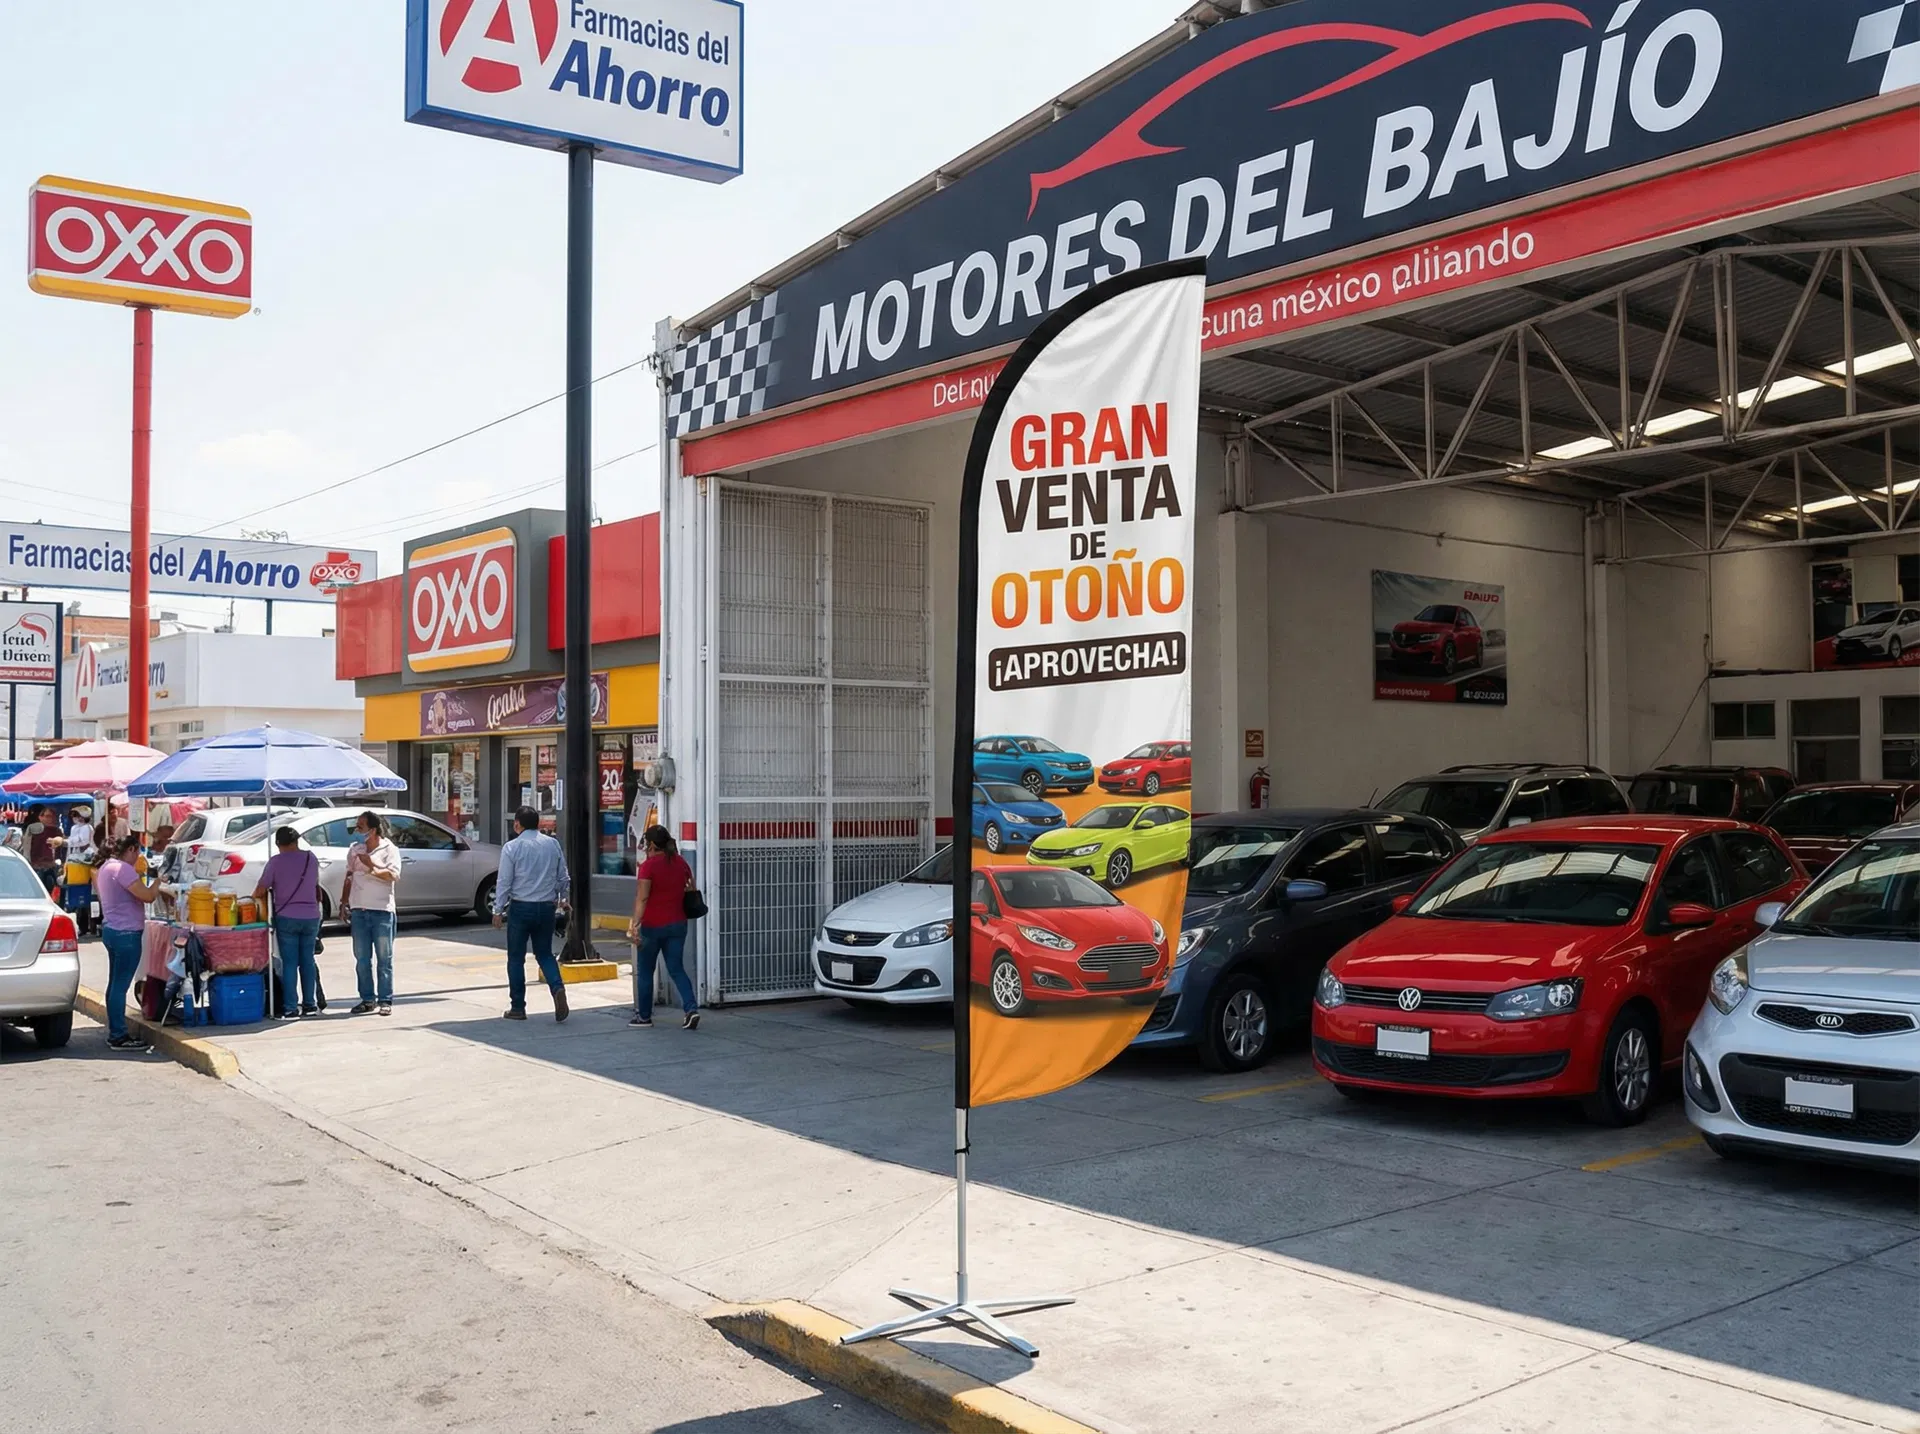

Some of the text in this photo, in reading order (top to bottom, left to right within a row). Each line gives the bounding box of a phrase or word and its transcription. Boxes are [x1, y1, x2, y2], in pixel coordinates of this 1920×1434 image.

[571, 0, 729, 65] Farmacias del
[549, 39, 730, 127] Ahorro
[810, 0, 1723, 381] MOTORES DEL BAJÍO
[45, 206, 244, 285] OXXO
[1271, 273, 1382, 322] méxico
[1010, 402, 1168, 472] GRAN
[995, 464, 1182, 533] VENTA
[150, 546, 184, 577] del
[188, 549, 300, 589] Ahorro
[1070, 531, 1106, 561] DE
[412, 560, 507, 642] OXXO
[991, 548, 1185, 629] OTOÑO
[995, 640, 1179, 687] ¡APROVECHA!
